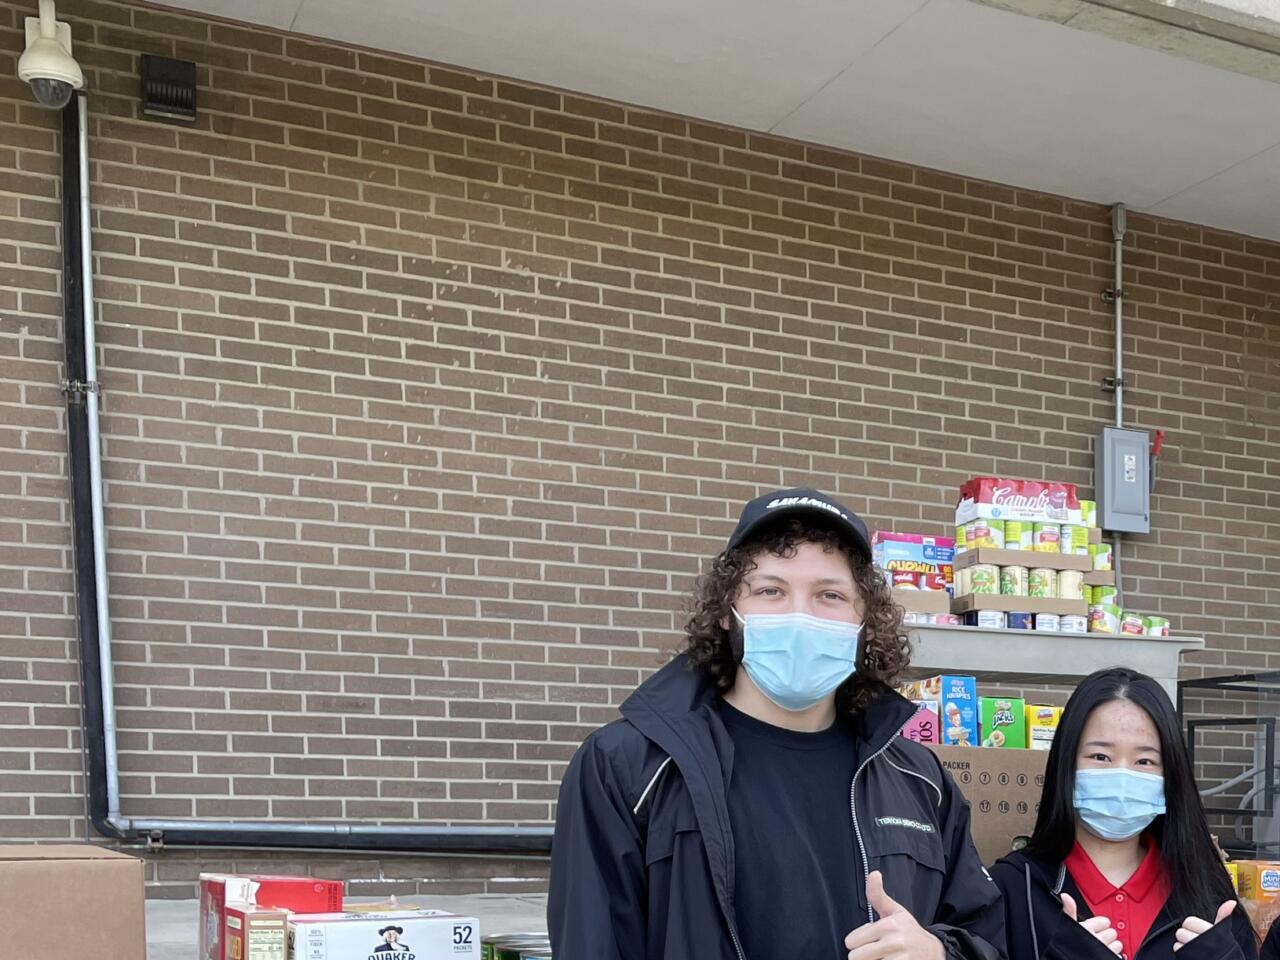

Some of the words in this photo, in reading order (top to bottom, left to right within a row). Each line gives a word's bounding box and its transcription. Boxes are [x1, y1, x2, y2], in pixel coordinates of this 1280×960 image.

[951, 686, 966, 694] RICE
[943, 761, 971, 770] PACKER
[453, 926, 472, 944] 52
